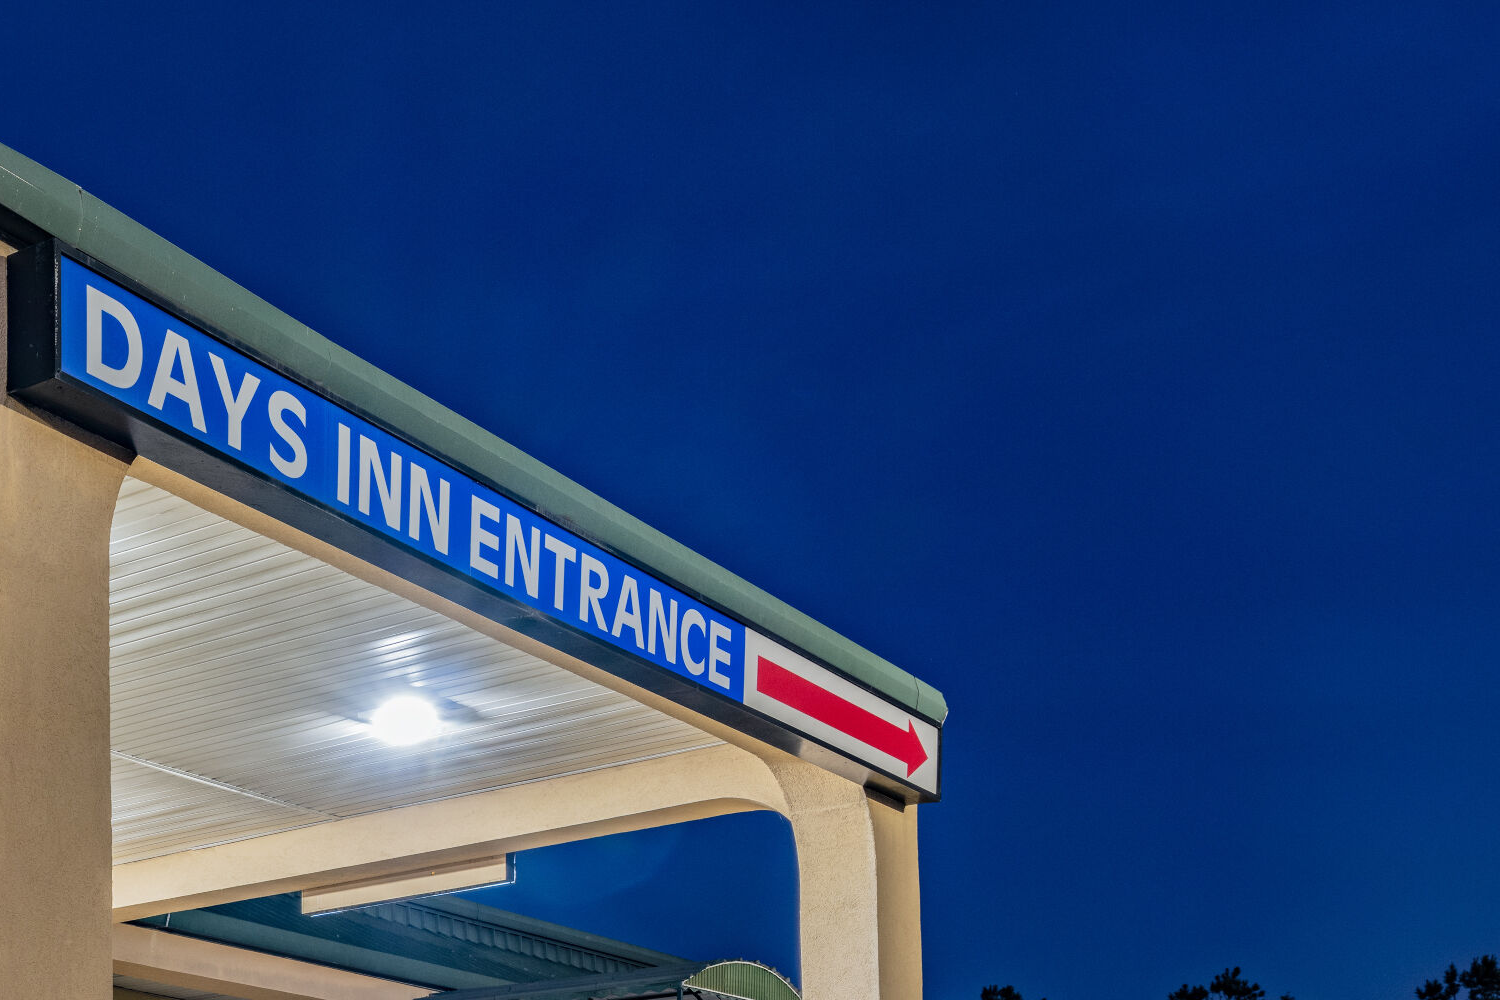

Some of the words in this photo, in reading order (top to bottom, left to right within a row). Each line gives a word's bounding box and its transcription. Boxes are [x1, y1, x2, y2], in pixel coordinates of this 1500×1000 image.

[86, 284, 308, 479] DAYS
[337, 422, 451, 556] INN
[470, 494, 732, 690] ENTRANCE
